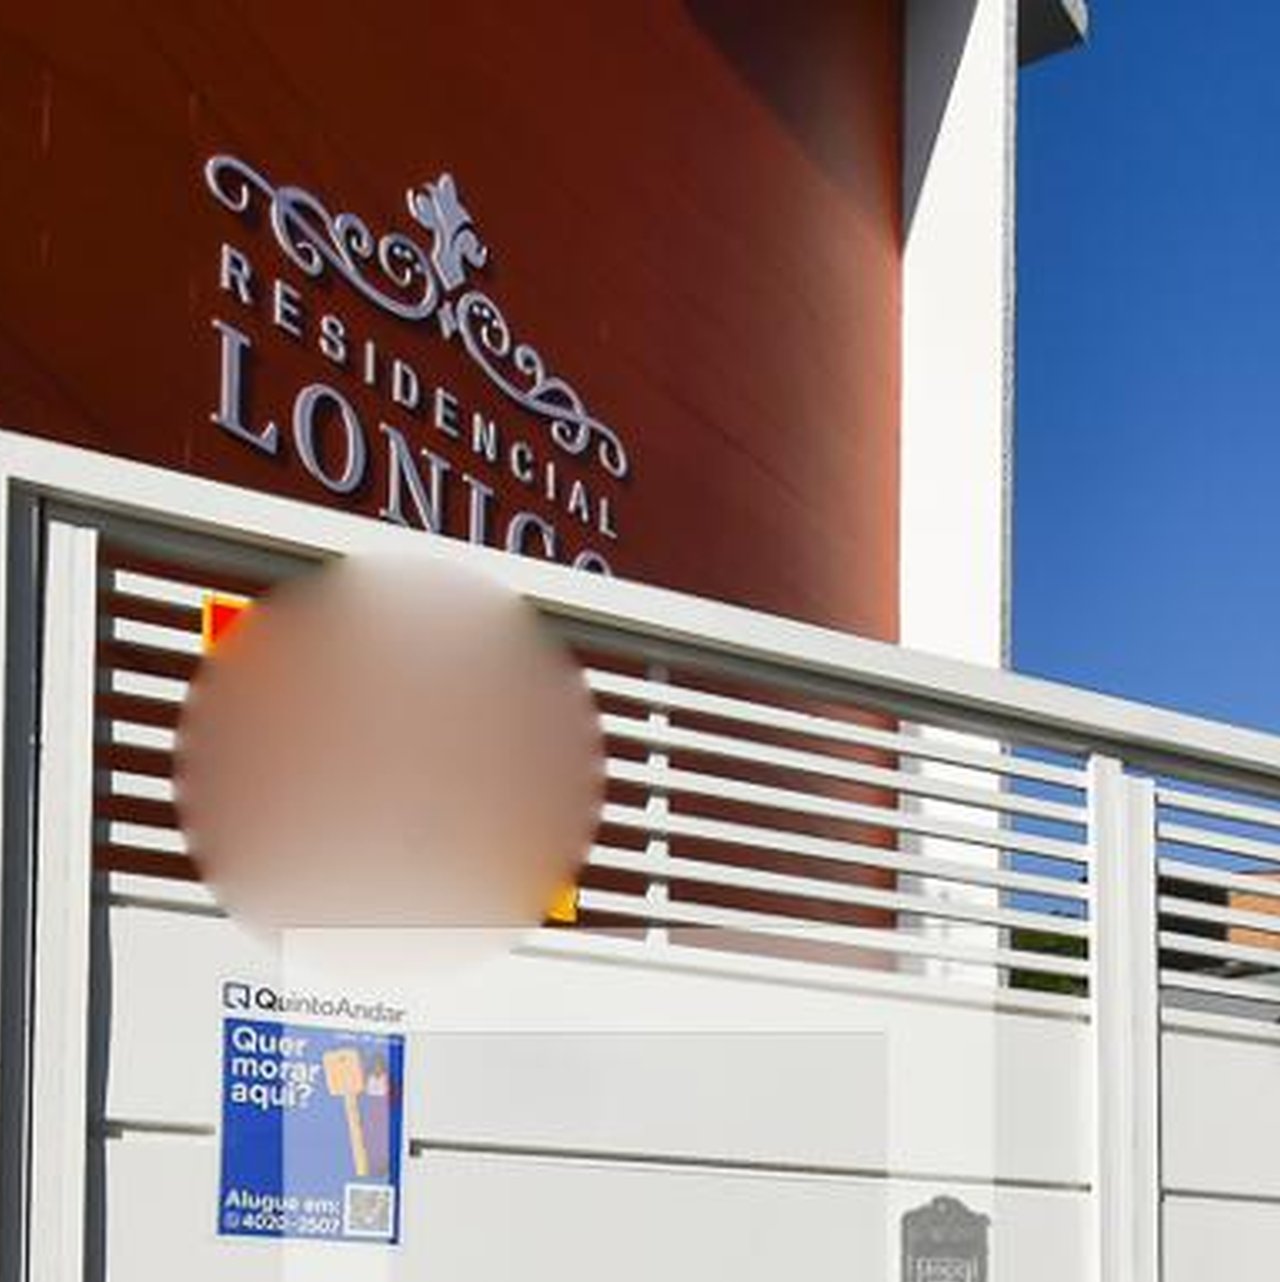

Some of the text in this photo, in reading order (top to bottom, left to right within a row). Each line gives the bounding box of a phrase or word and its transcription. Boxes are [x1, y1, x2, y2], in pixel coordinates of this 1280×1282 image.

[221, 243, 617, 538] RESIDENCIAL
[210, 319, 612, 578] LONI
[255, 987, 405, 1022] QuintoAndar
[232, 1026, 307, 1055] Quer
[231, 1056, 320, 1083] morar
[231, 1082, 312, 1110] aqui?
[225, 1189, 299, 1212] Alugue
